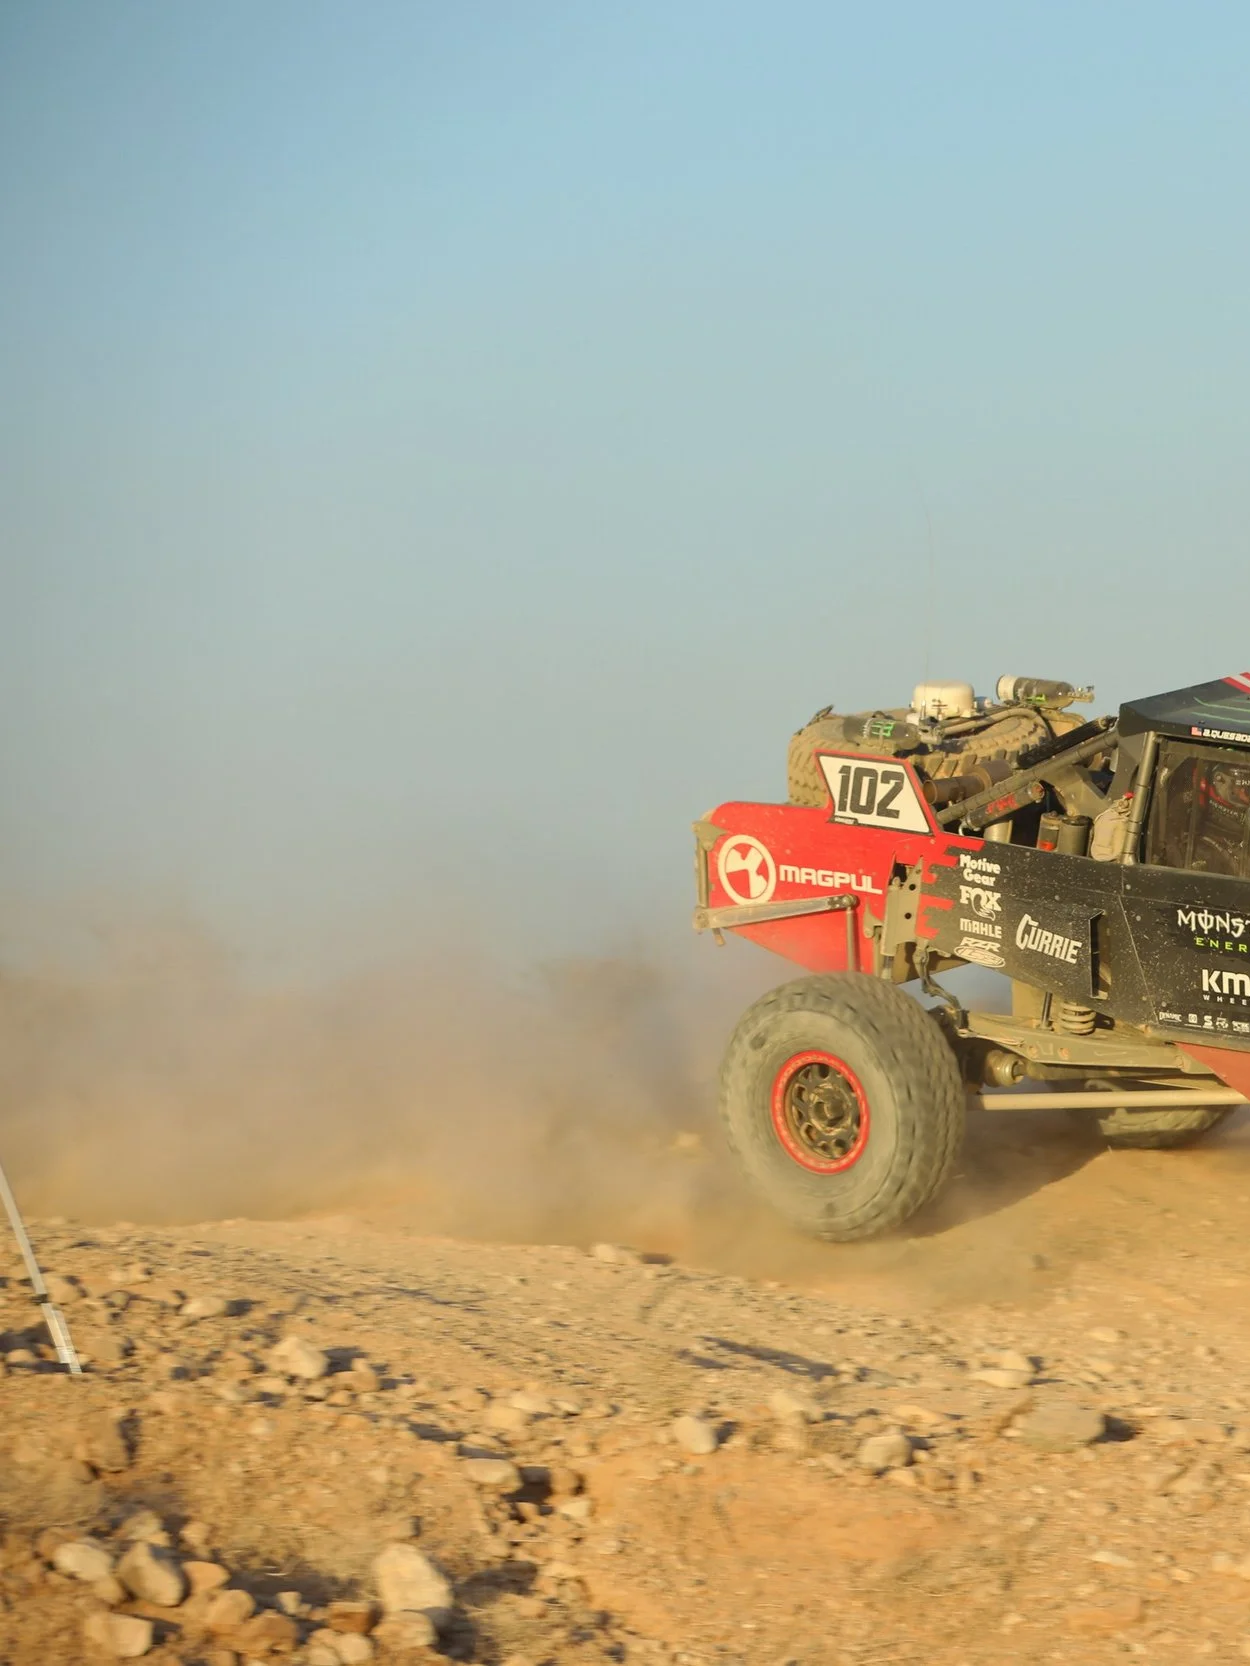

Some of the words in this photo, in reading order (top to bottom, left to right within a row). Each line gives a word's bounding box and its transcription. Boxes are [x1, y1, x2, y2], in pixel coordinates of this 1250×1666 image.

[837, 764, 905, 819] 102
[959, 854, 1001, 875] Motive
[779, 864, 883, 895] MAGPUL
[963, 867, 996, 887] Gear
[959, 885, 1002, 913] FOX
[959, 918, 1002, 939] MAHLE
